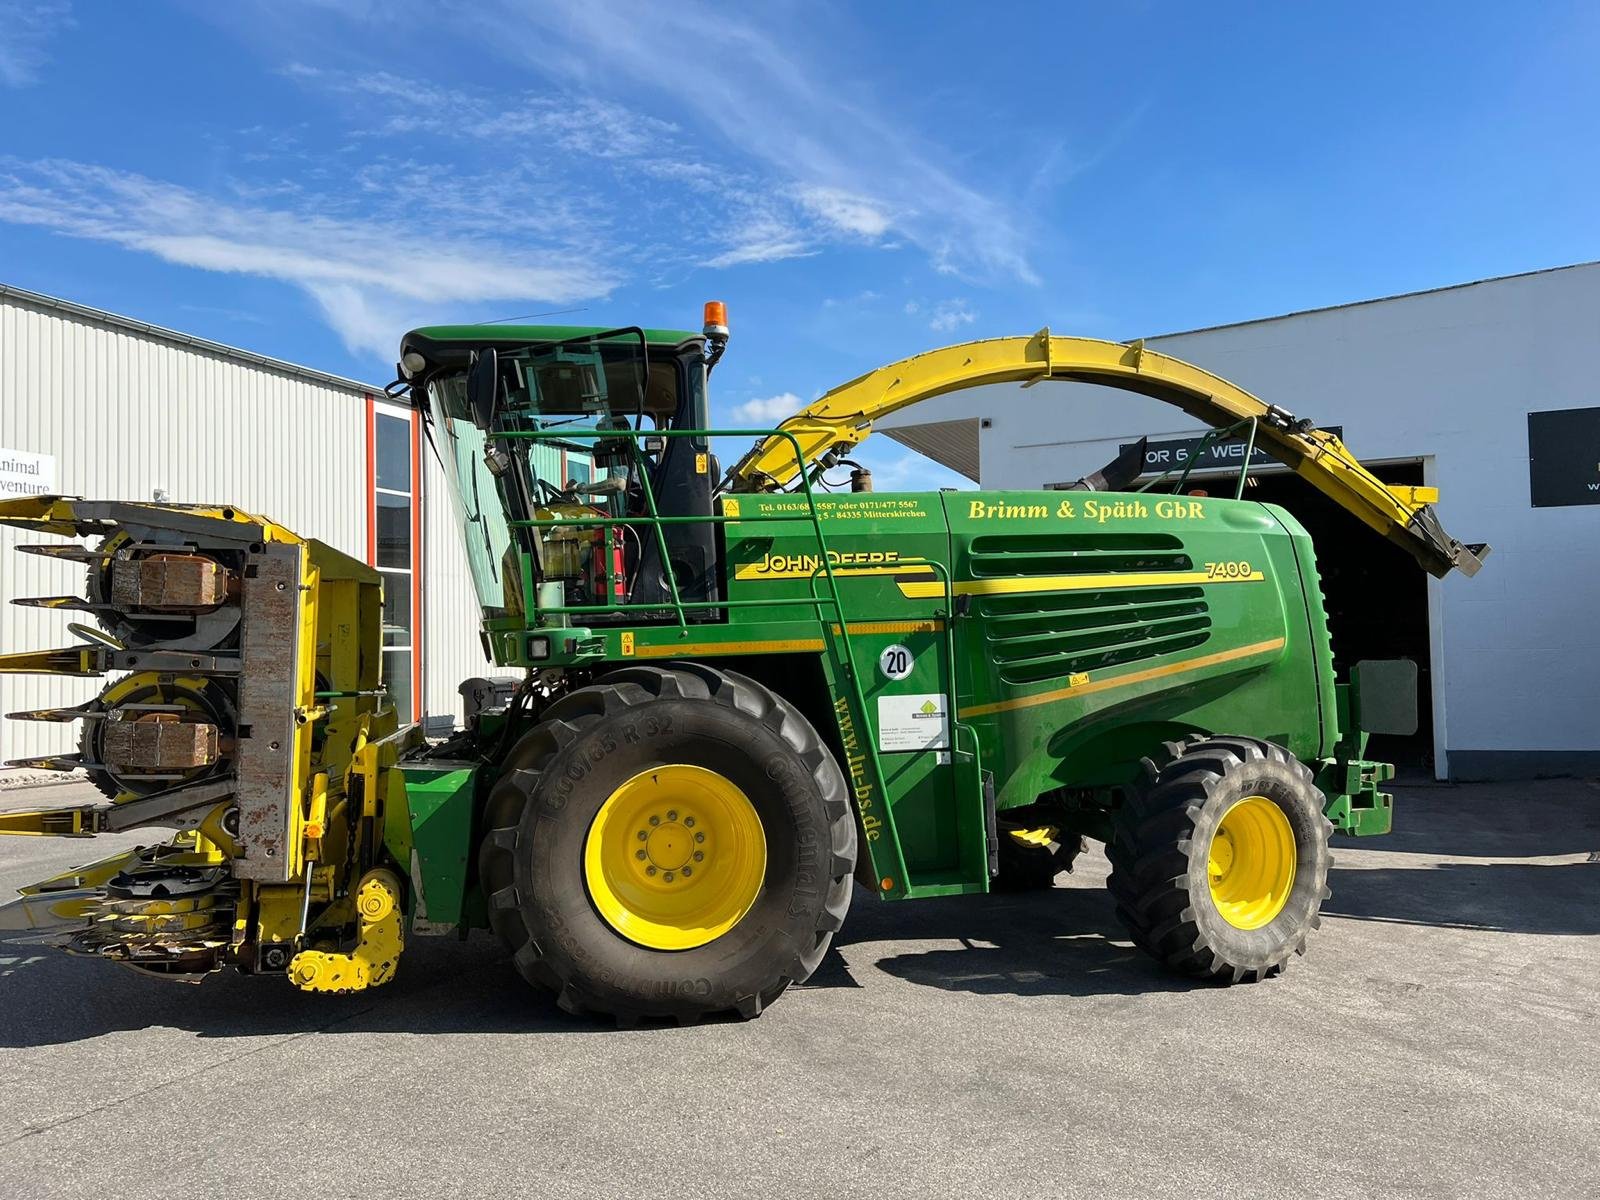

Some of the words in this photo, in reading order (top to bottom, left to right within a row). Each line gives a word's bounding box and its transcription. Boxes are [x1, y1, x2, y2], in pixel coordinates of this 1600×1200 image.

[1144, 450, 1170, 464] OR
[0, 458, 40, 476] nimal
[758, 503, 775, 512] Tel.
[776, 503, 816, 511] 0163/68
[816, 502, 837, 510] 5587
[838, 501, 859, 510] oder
[859, 501, 897, 510] 0171/477
[898, 500, 918, 509] 5567
[863, 510, 927, 519] Mitterskirchen
[968, 500, 1049, 519] Brimm
[1056, 500, 1077, 519] &
[1084, 500, 1149, 523] Späth
[1155, 499, 1206, 519] GbR
[757, 553, 819, 573] JOHN
[1204, 561, 1252, 579] 7400
[886, 651, 907, 674] 20
[622, 723, 642, 745] R
[835, 697, 881, 841] www.lu-bs.de
